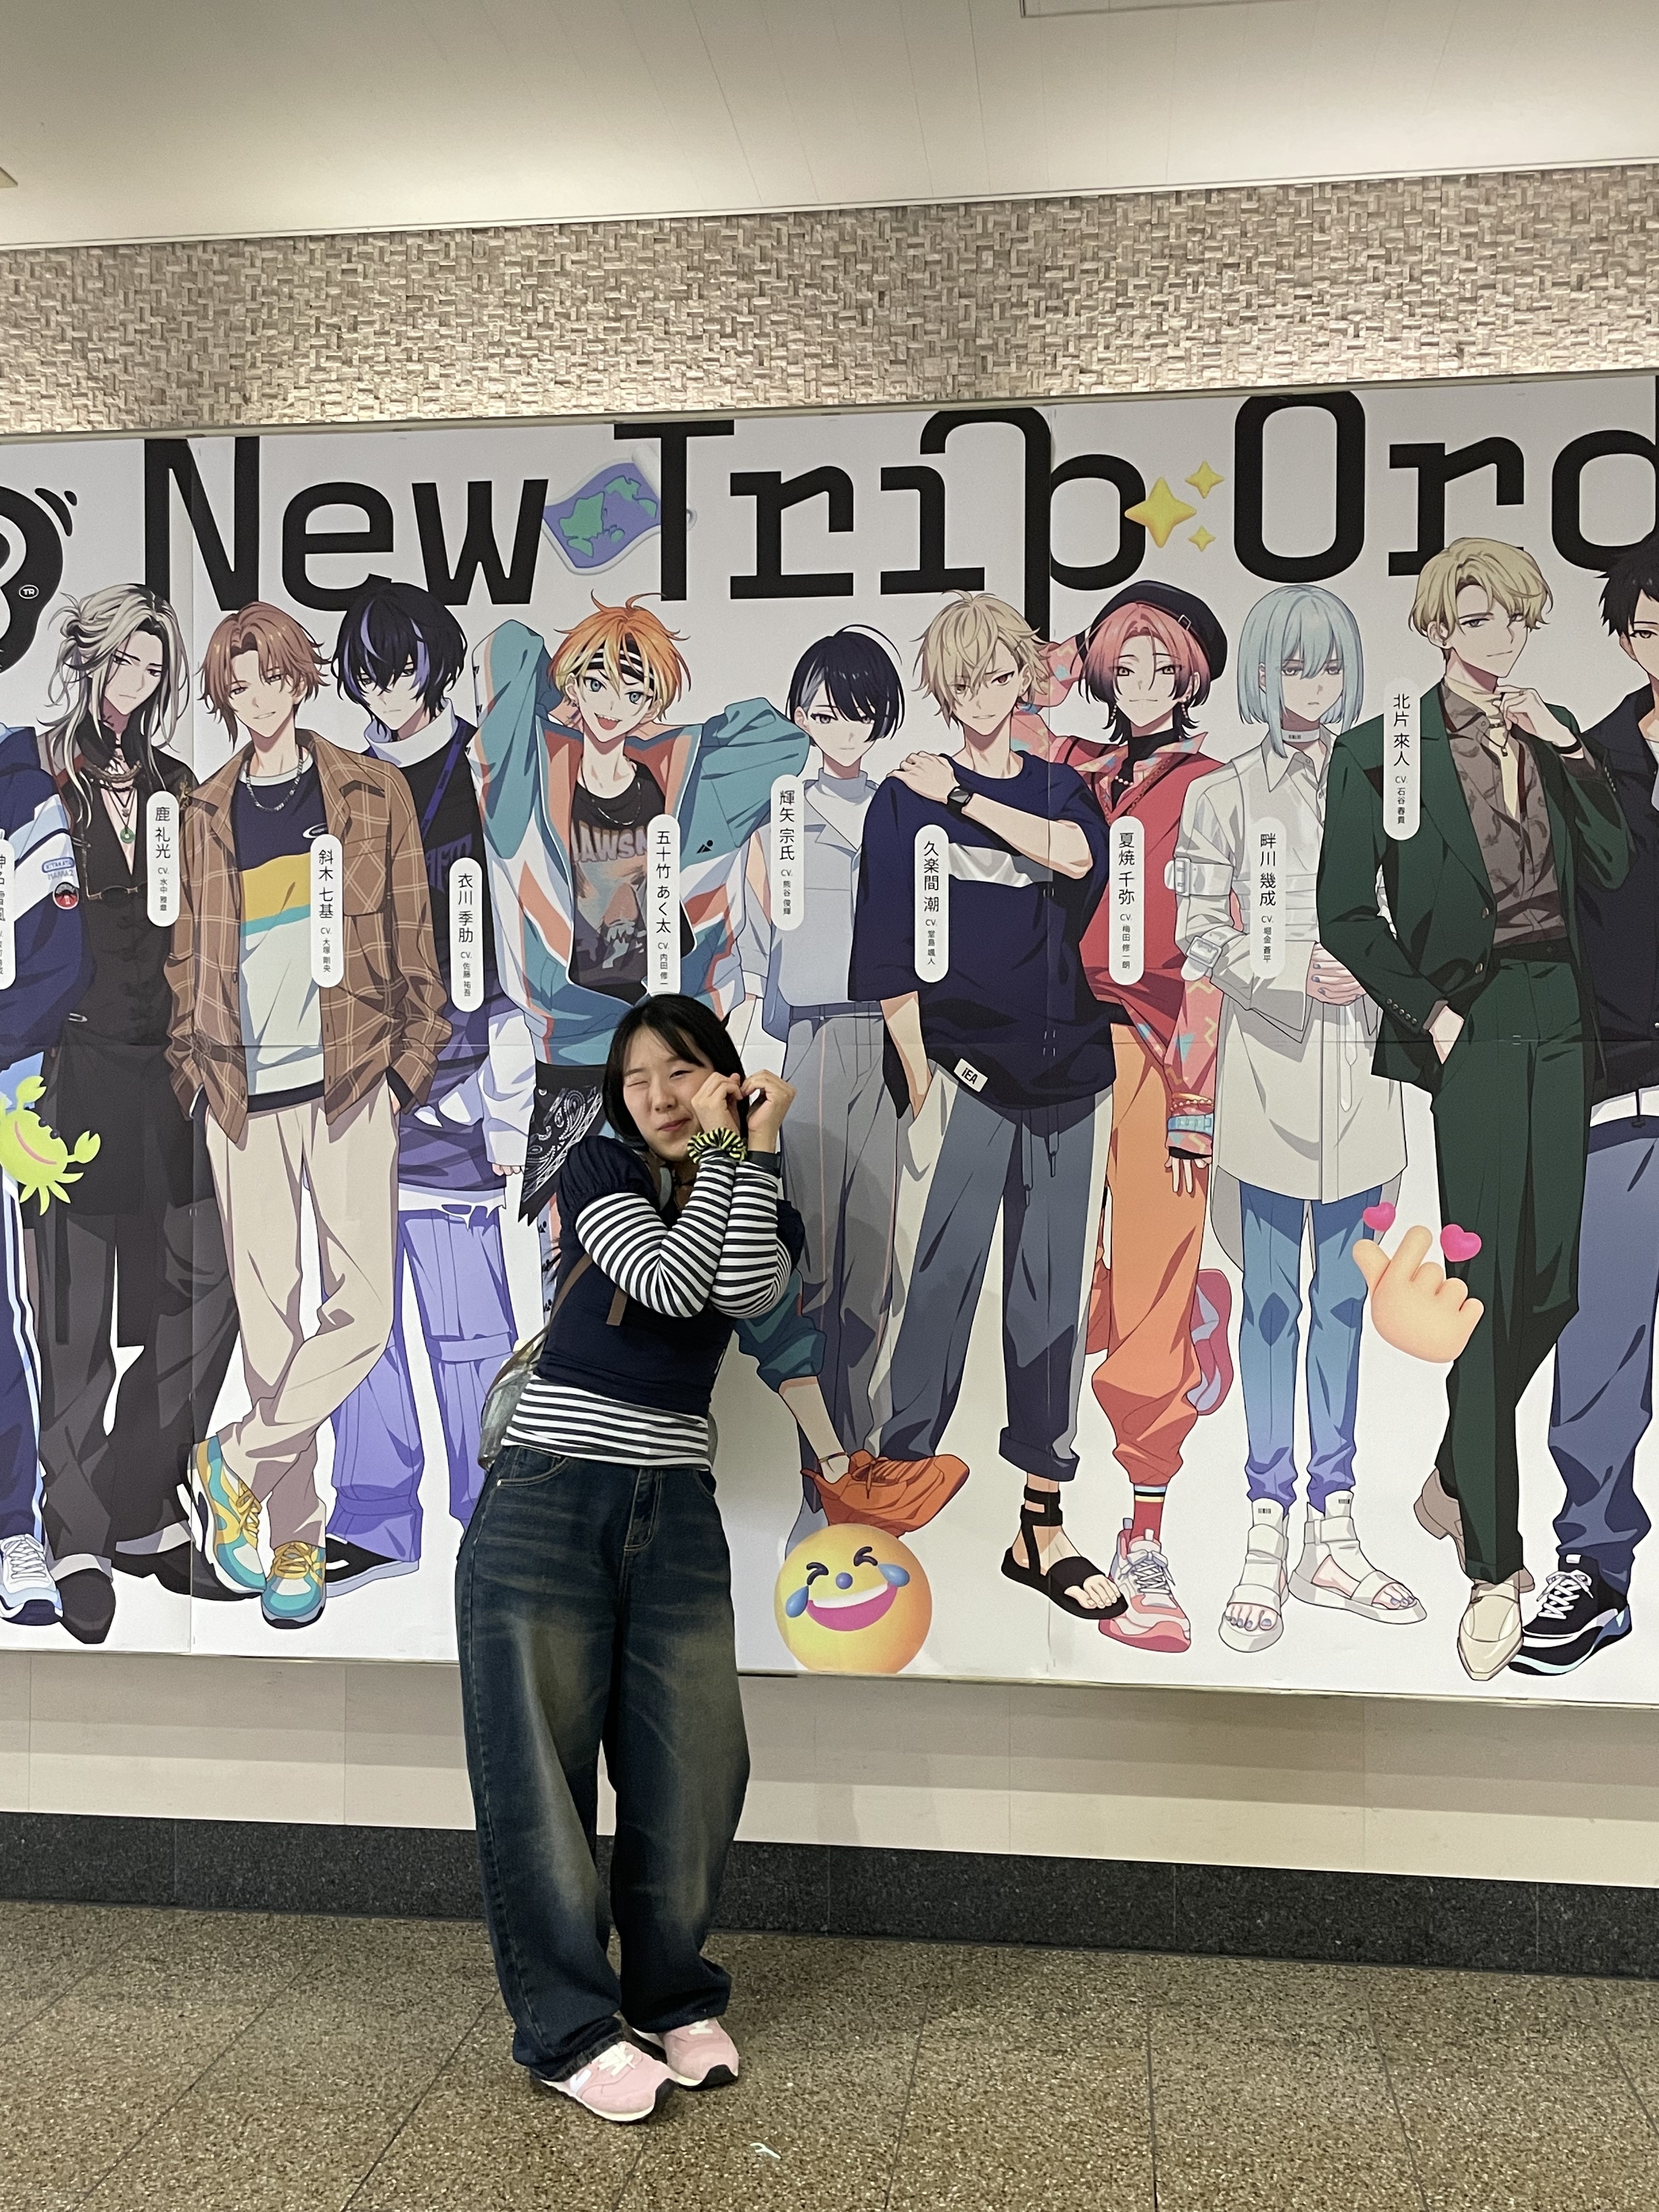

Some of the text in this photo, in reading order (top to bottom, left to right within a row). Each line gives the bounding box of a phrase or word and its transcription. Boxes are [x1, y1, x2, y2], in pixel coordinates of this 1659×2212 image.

[144, 436, 549, 611] New
[613, 407, 1146, 644] Trip
[1393, 693, 1410, 727] 北片
[1393, 732, 1410, 767] 來人
[155, 806, 171, 822] 鹿
[779, 789, 795, 823] 輝矢
[155, 826, 171, 859] 礼光
[656, 830, 672, 879] 五十竹
[779, 827, 795, 861] 宗氏
[1118, 832, 1135, 866] 夏焼
[1260, 832, 1277, 867] 畔川
[318, 848, 334, 882] 斜木
[923, 840, 939, 891] 久楽間
[160, 878, 168, 894] 水中
[318, 887, 334, 919] 七基
[458, 873, 473, 906] 衣川
[1118, 871, 1135, 905] 千弥
[1259, 872, 1277, 907] 幾成
[656, 885, 672, 934] あく太
[923, 896, 939, 913] 潮
[458, 910, 473, 943] 季肋
